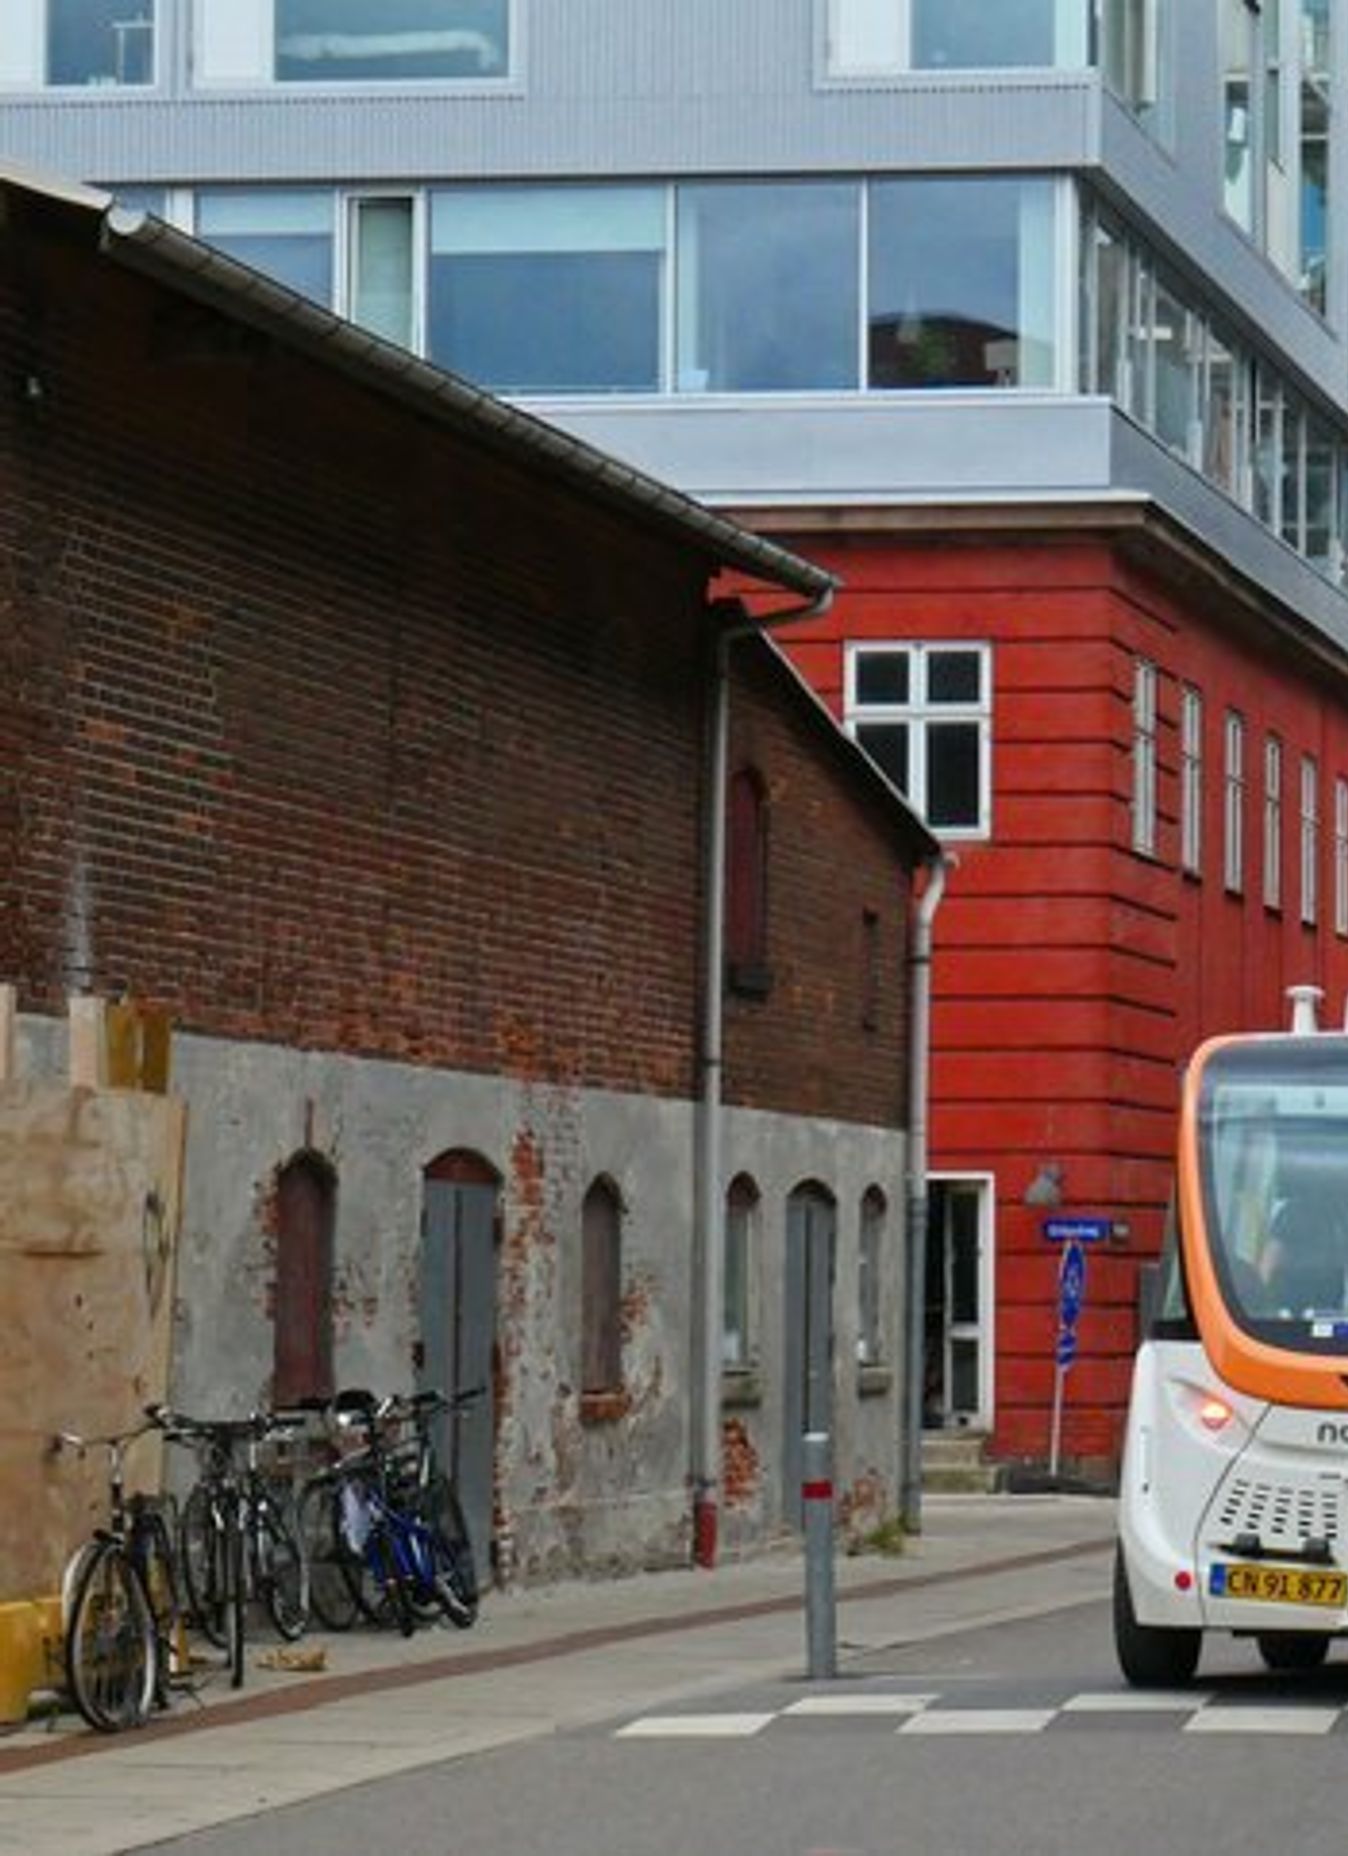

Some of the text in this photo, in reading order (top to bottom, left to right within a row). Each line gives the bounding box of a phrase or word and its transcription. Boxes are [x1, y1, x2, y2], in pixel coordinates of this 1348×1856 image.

[1228, 1570, 1342, 1600] CN 91 877
